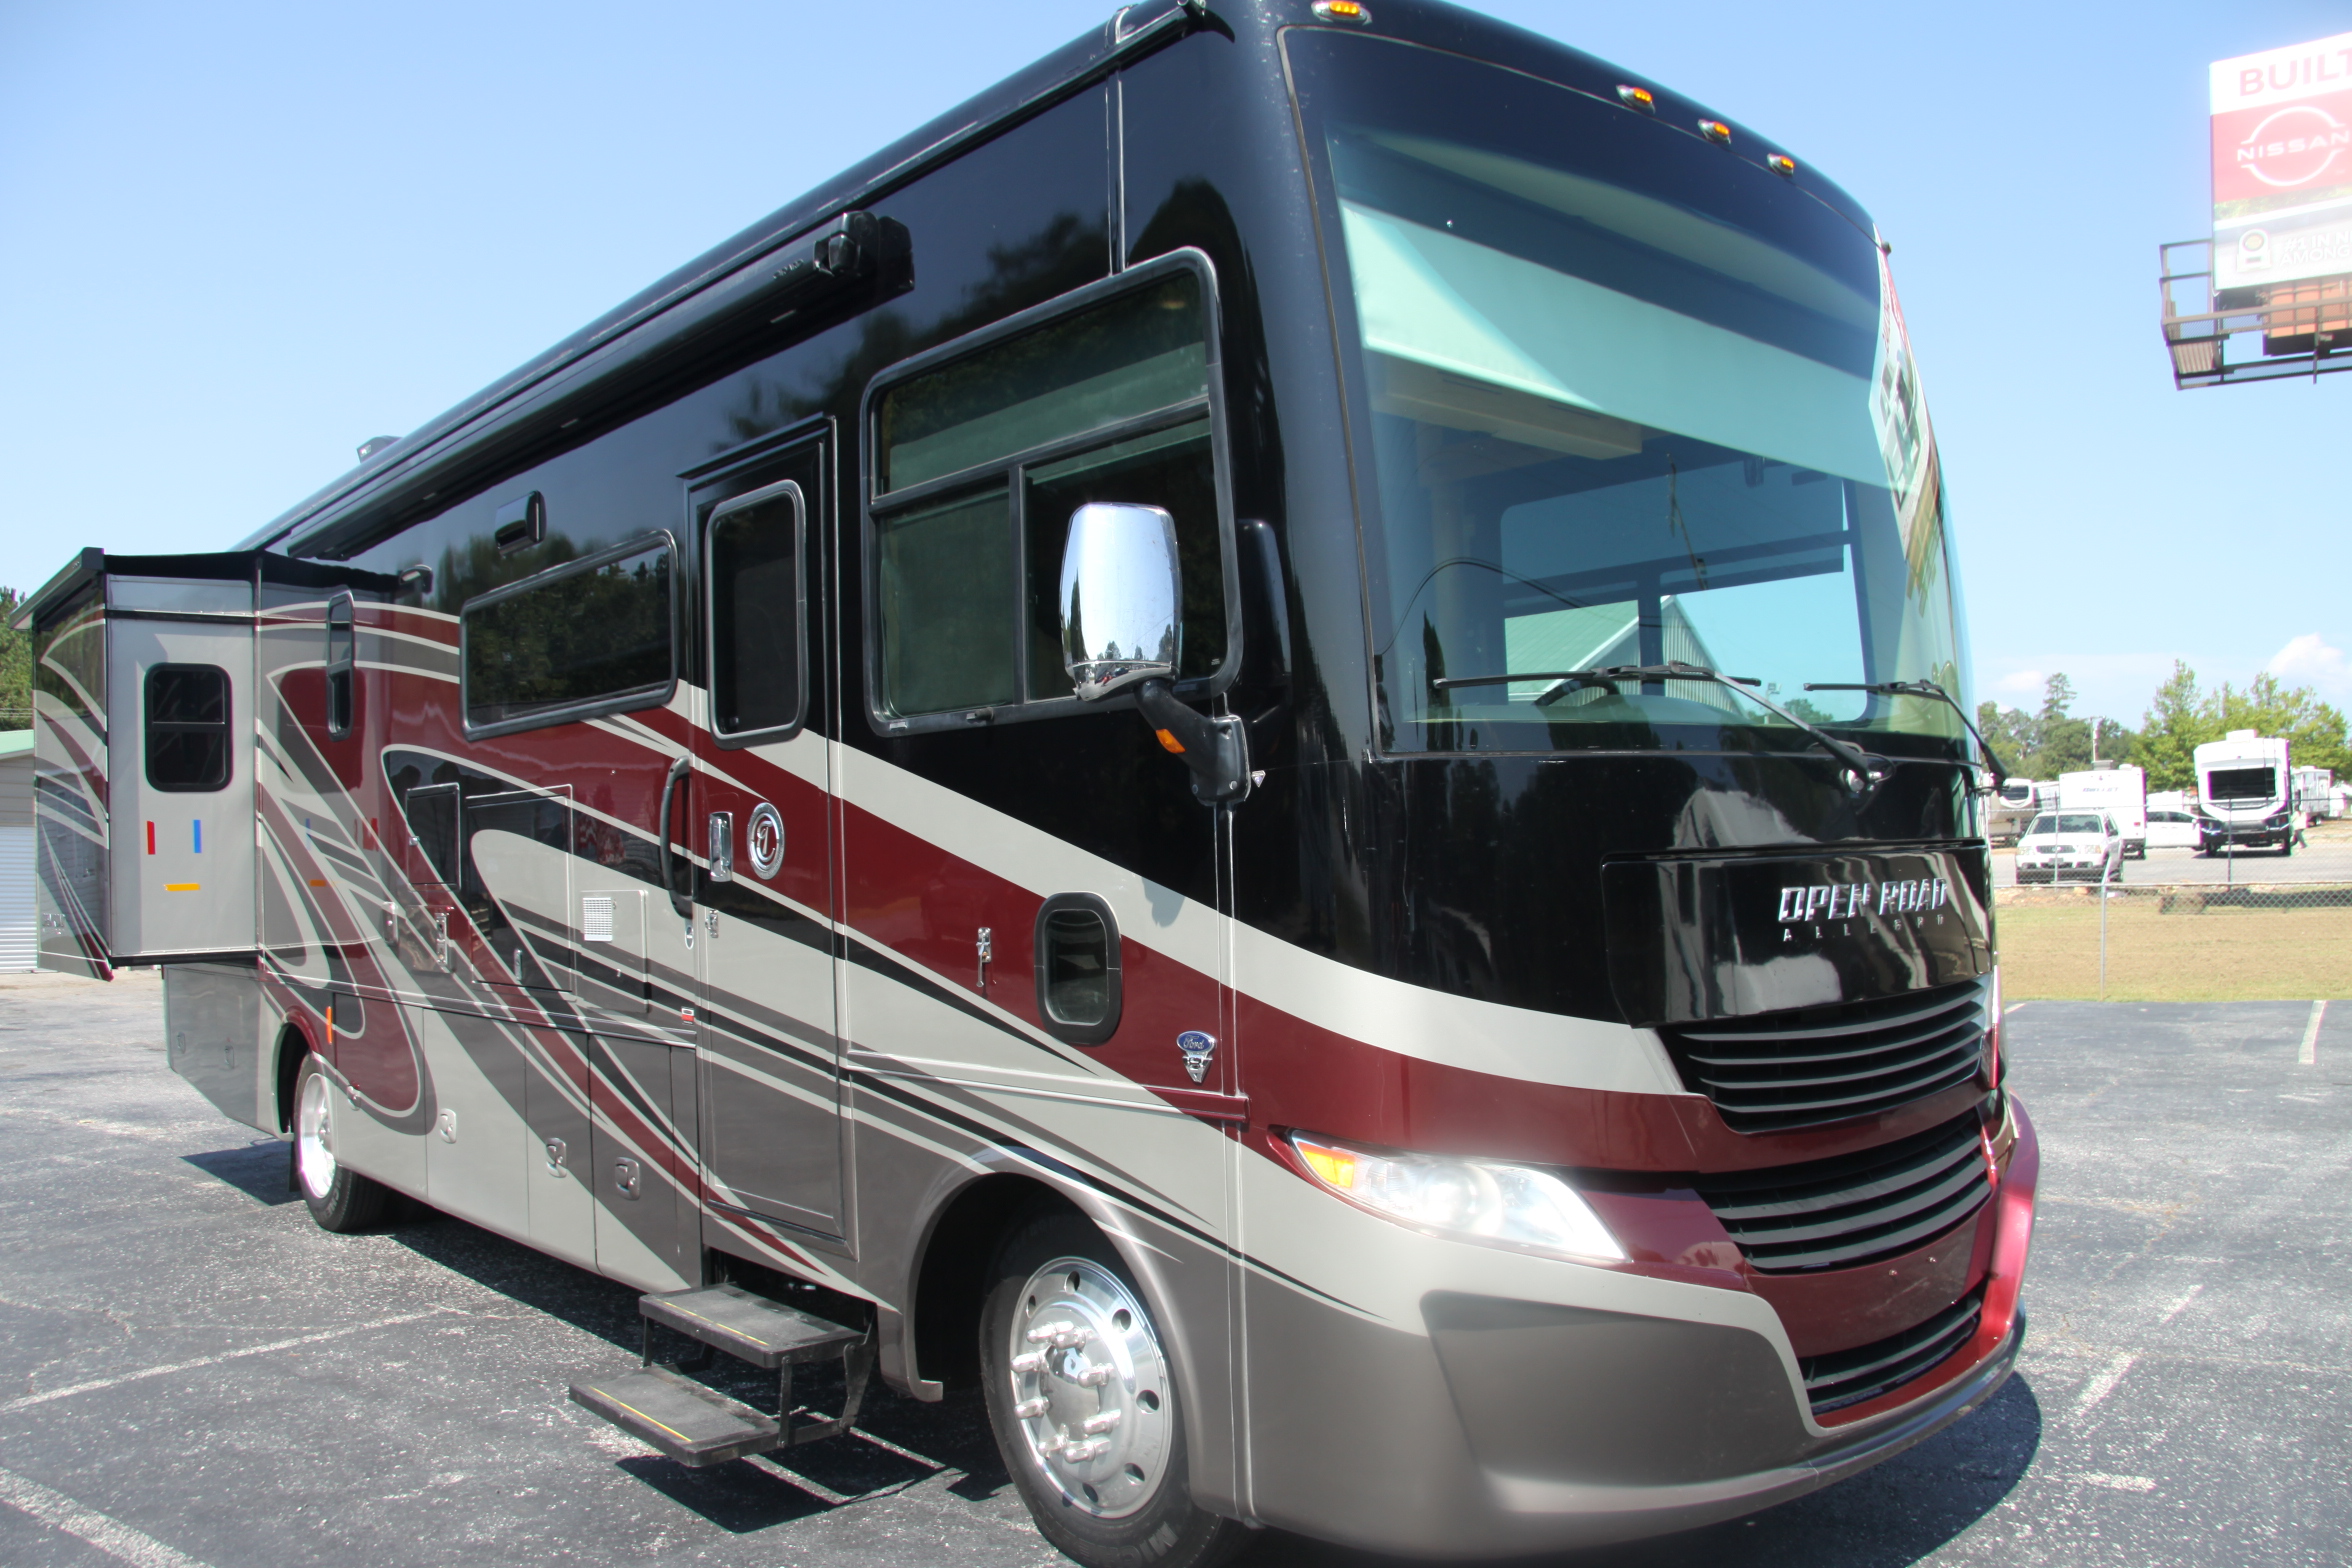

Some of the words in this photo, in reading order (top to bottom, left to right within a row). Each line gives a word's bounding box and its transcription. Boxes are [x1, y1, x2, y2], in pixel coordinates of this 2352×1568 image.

[2236, 130, 2350, 162] NISSAN
[2311, 232, 2330, 248] IN
[2279, 244, 2350, 266] AMONG
[1778, 882, 1871, 923] OPEN
[1878, 877, 1948, 916] ROAD
[1183, 1035, 1205, 1050] Ford
